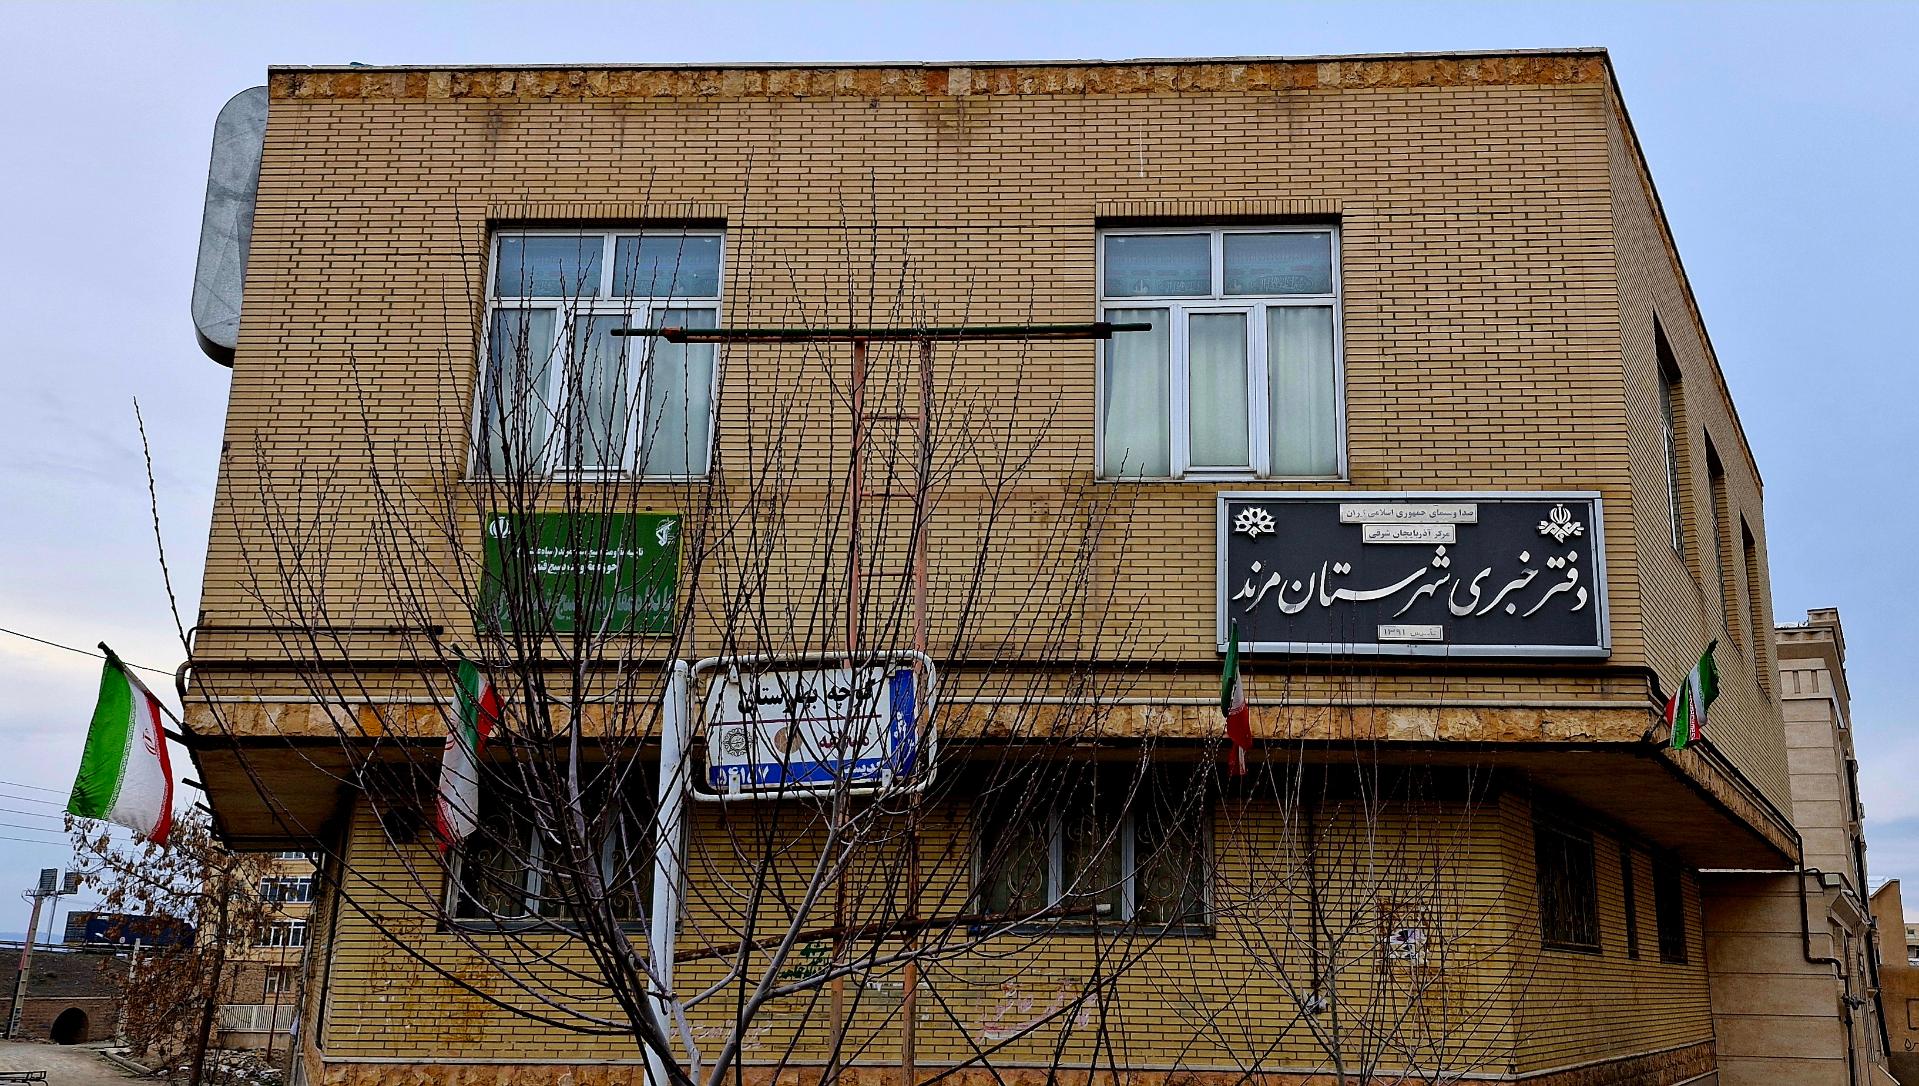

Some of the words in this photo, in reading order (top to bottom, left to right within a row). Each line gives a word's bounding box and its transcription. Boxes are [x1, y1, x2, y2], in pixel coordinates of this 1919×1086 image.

[1367, 509, 1394, 518] اسلامی
[1395, 510, 1426, 518] جمهوری
[1459, 509, 1474, 517] صدا
[1368, 529, 1391, 539] شرقی
[1392, 528, 1431, 539] آذربایجان
[1434, 529, 1450, 540] مرکز
[1232, 560, 1281, 613] مرند
[1278, 544, 1451, 618] شهرستان
[1448, 550, 1539, 617] خبری
[1522, 550, 1588, 617] دفتر
[1384, 628, 1405, 637] ۱۳۹۱
